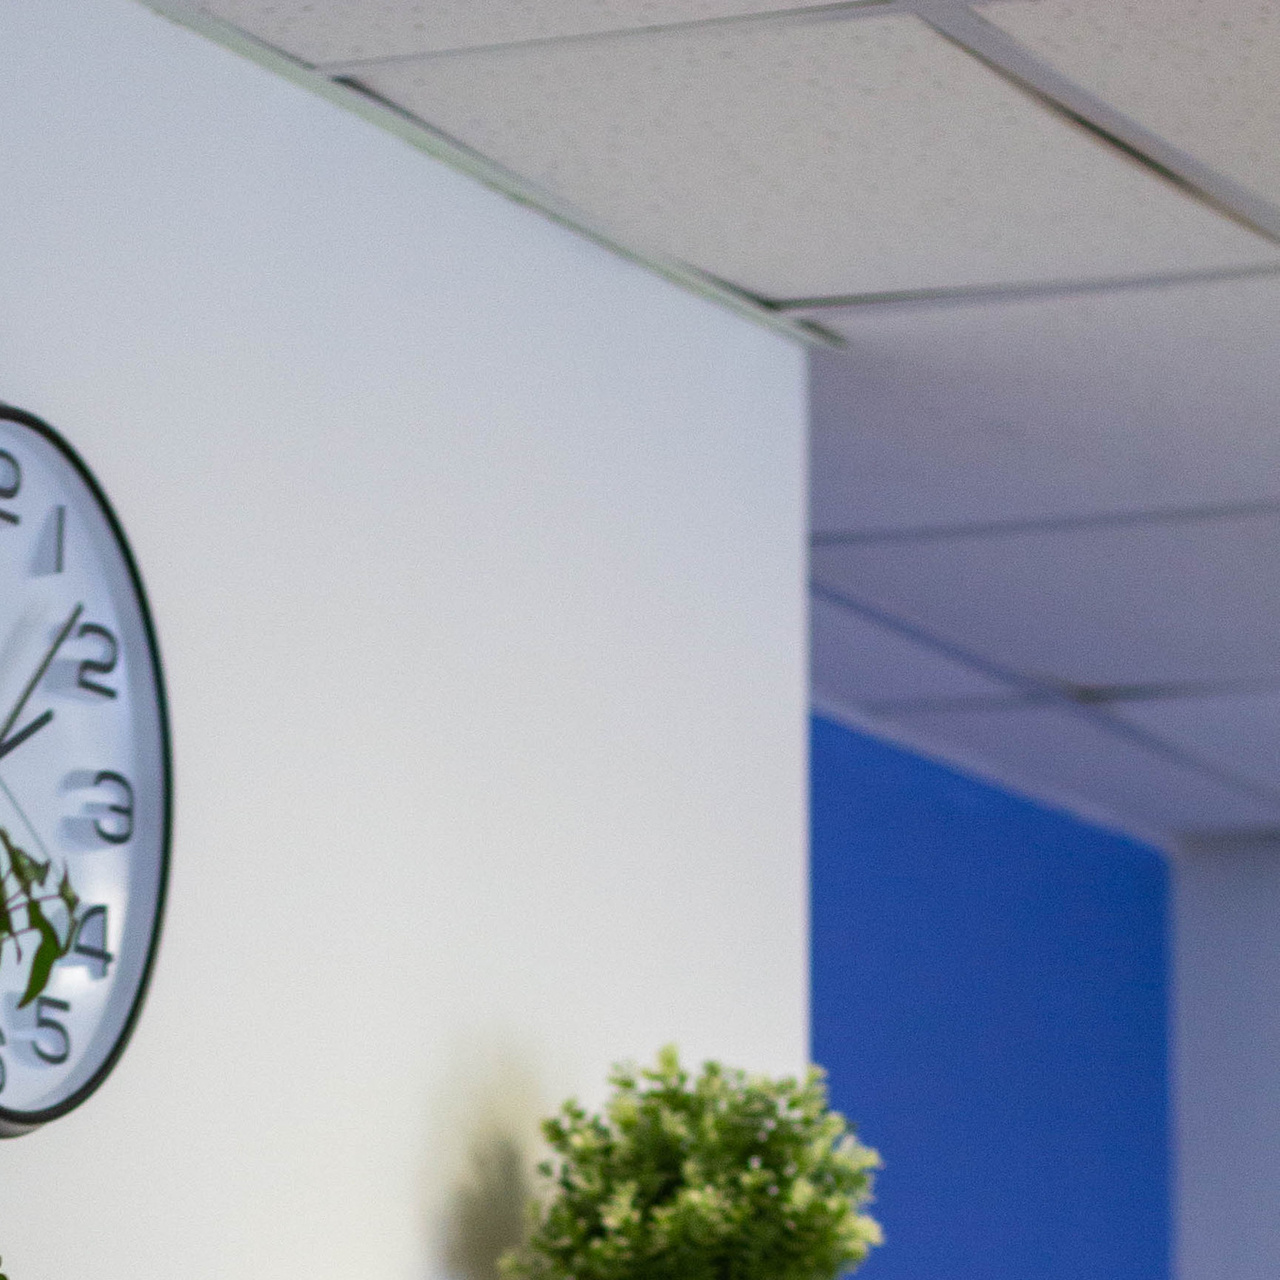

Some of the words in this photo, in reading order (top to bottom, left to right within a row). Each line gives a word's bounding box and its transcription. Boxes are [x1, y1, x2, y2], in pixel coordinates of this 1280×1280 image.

[56, 505, 68, 574] 1
[76, 623, 119, 699] 2
[93, 770, 135, 844] 3
[74, 905, 113, 980] 4
[32, 996, 70, 1065] 5
